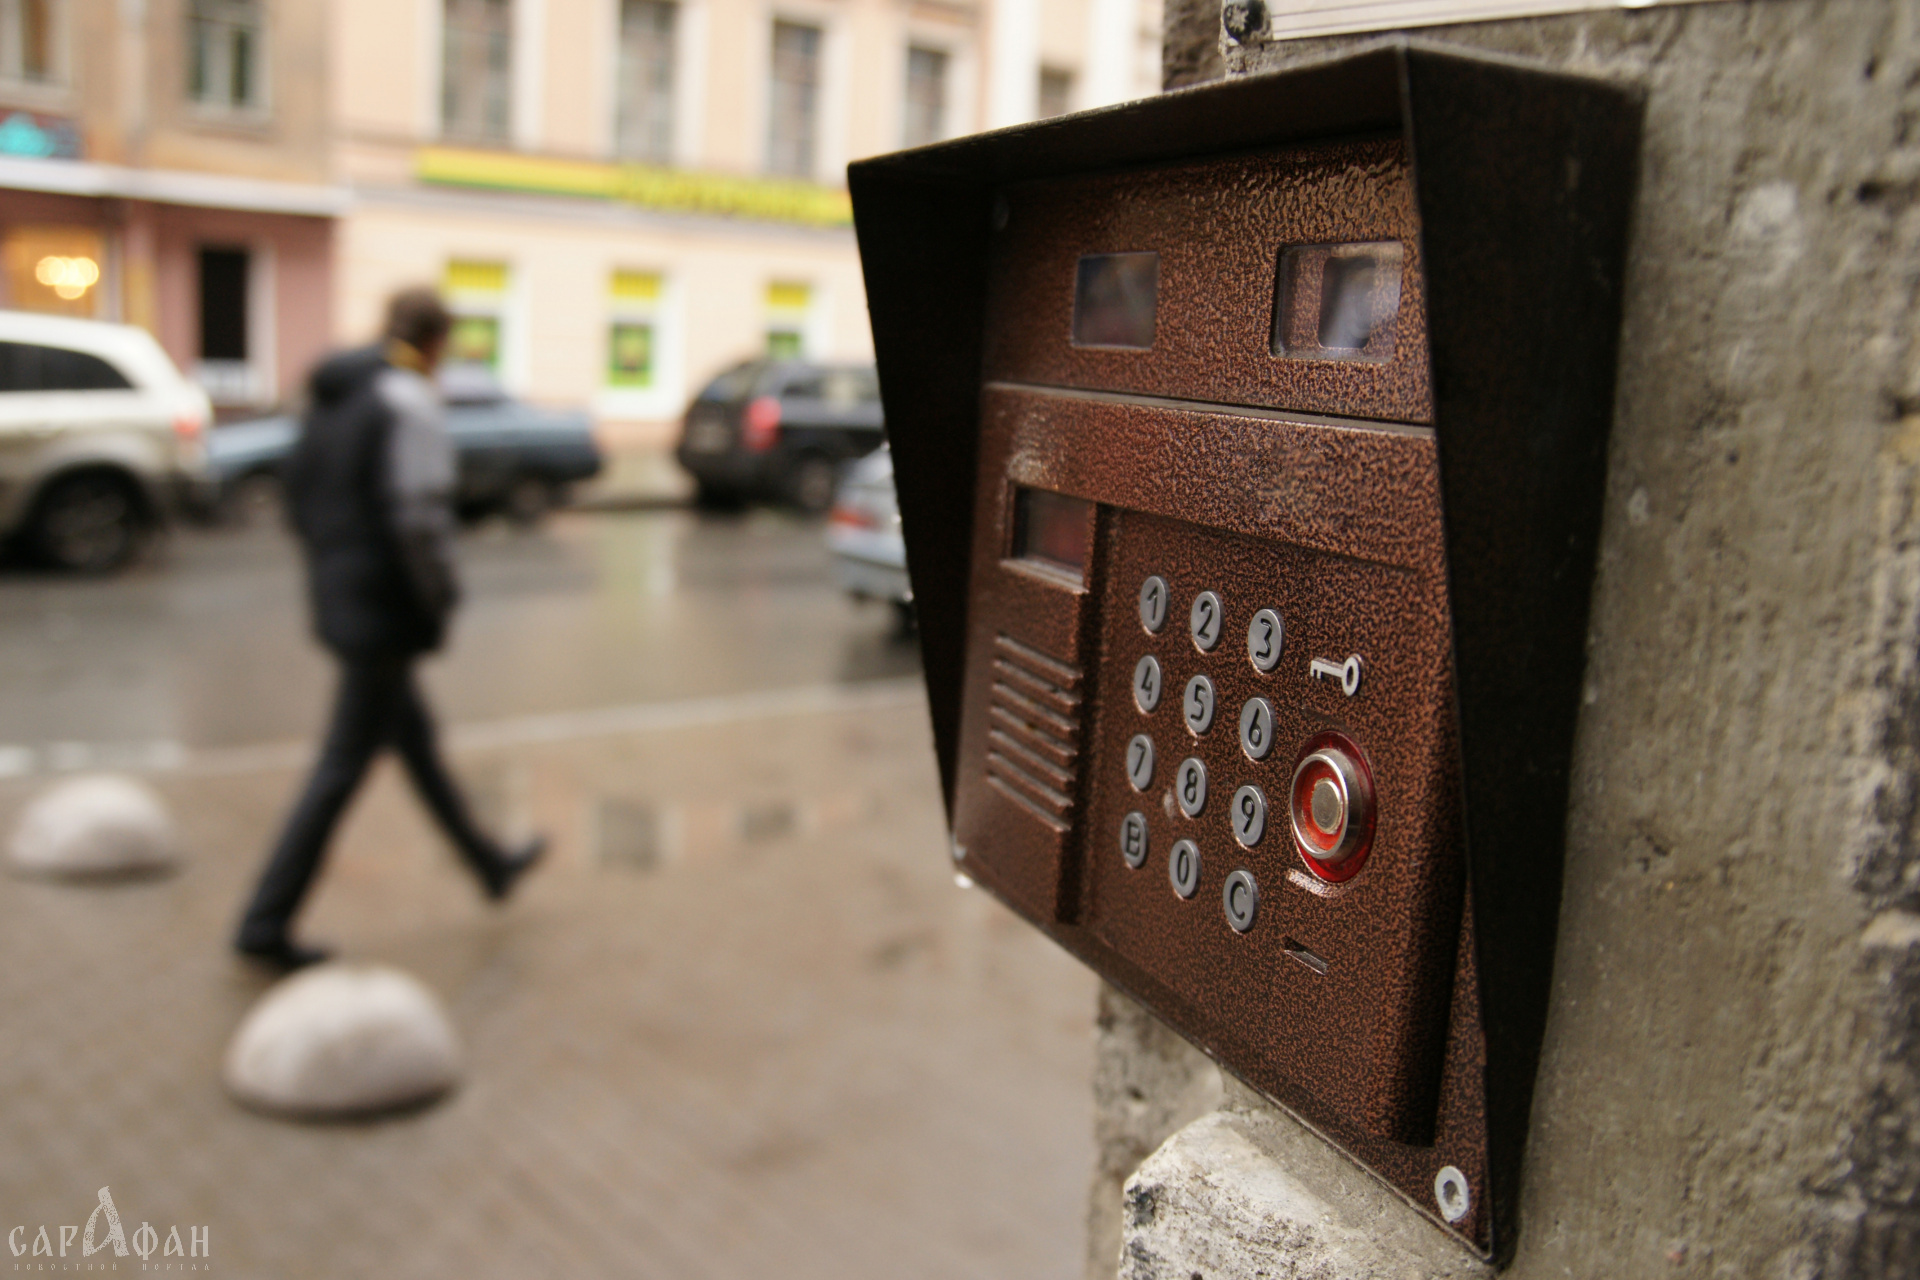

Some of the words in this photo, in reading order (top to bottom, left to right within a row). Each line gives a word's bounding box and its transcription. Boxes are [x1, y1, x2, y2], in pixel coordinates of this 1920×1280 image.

[1196, 600, 1213, 641] 2
[1254, 618, 1274, 660] 3
[1190, 684, 1207, 722] 5
[1248, 708, 1263, 749] 6
[1183, 767, 1198, 807] 8
[1240, 795, 1256, 837] 9
